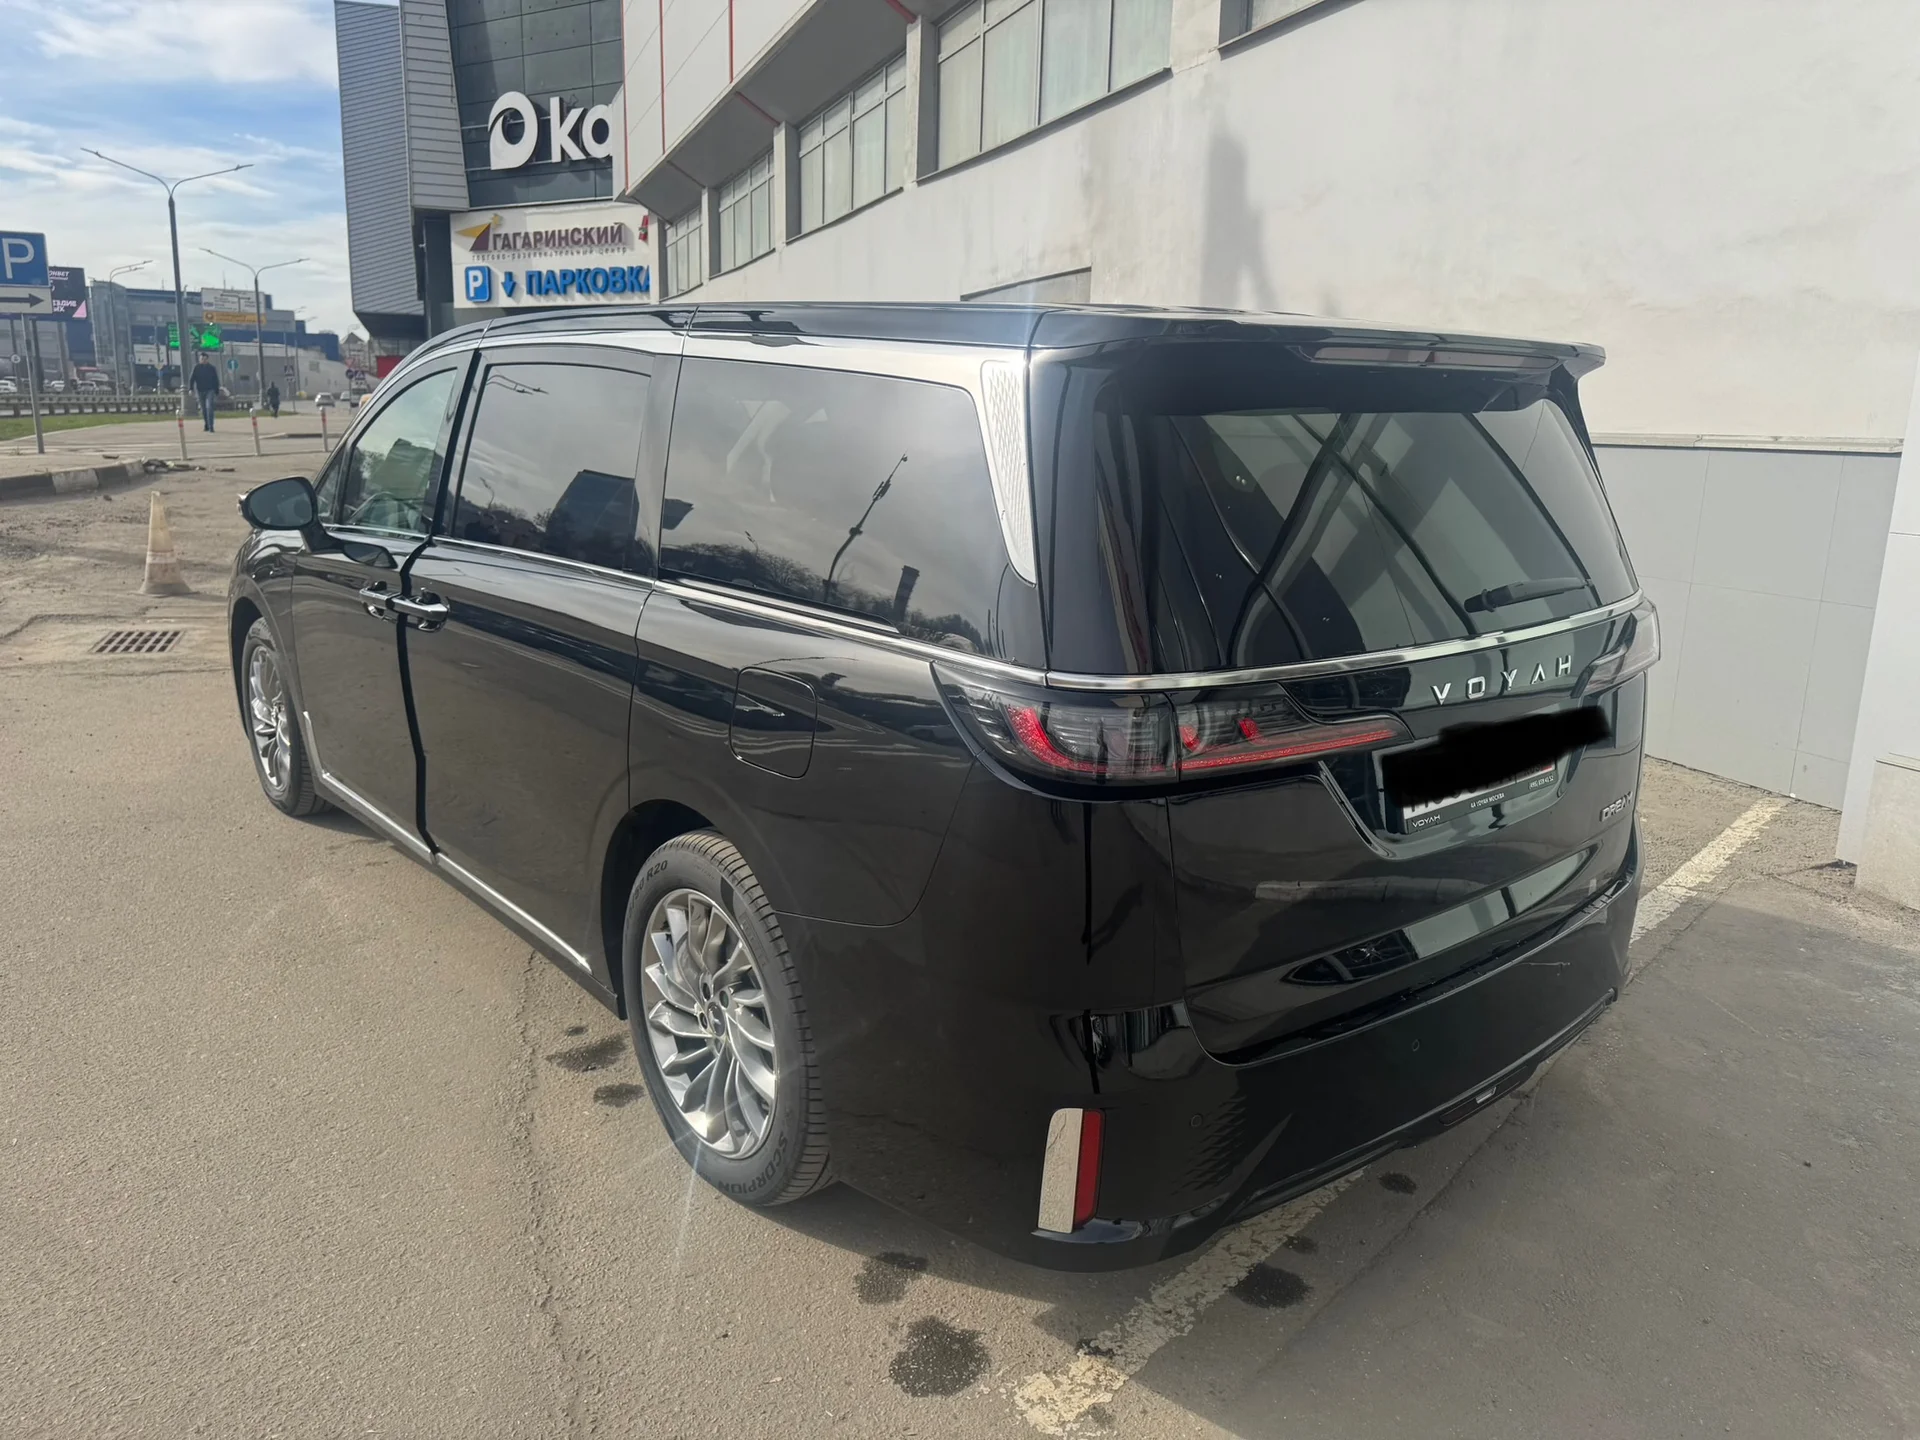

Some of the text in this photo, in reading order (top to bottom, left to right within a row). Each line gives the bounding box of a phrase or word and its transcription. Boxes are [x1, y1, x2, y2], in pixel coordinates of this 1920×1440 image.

[492, 222, 624, 251] ГАГАРИНСКИЙ
[2, 238, 35, 279] P
[1432, 655, 1572, 705] VOYAH
[1412, 814, 1441, 828] VOYAH
[646, 860, 668, 881] R20
[718, 1131, 788, 1194] SCORPION
